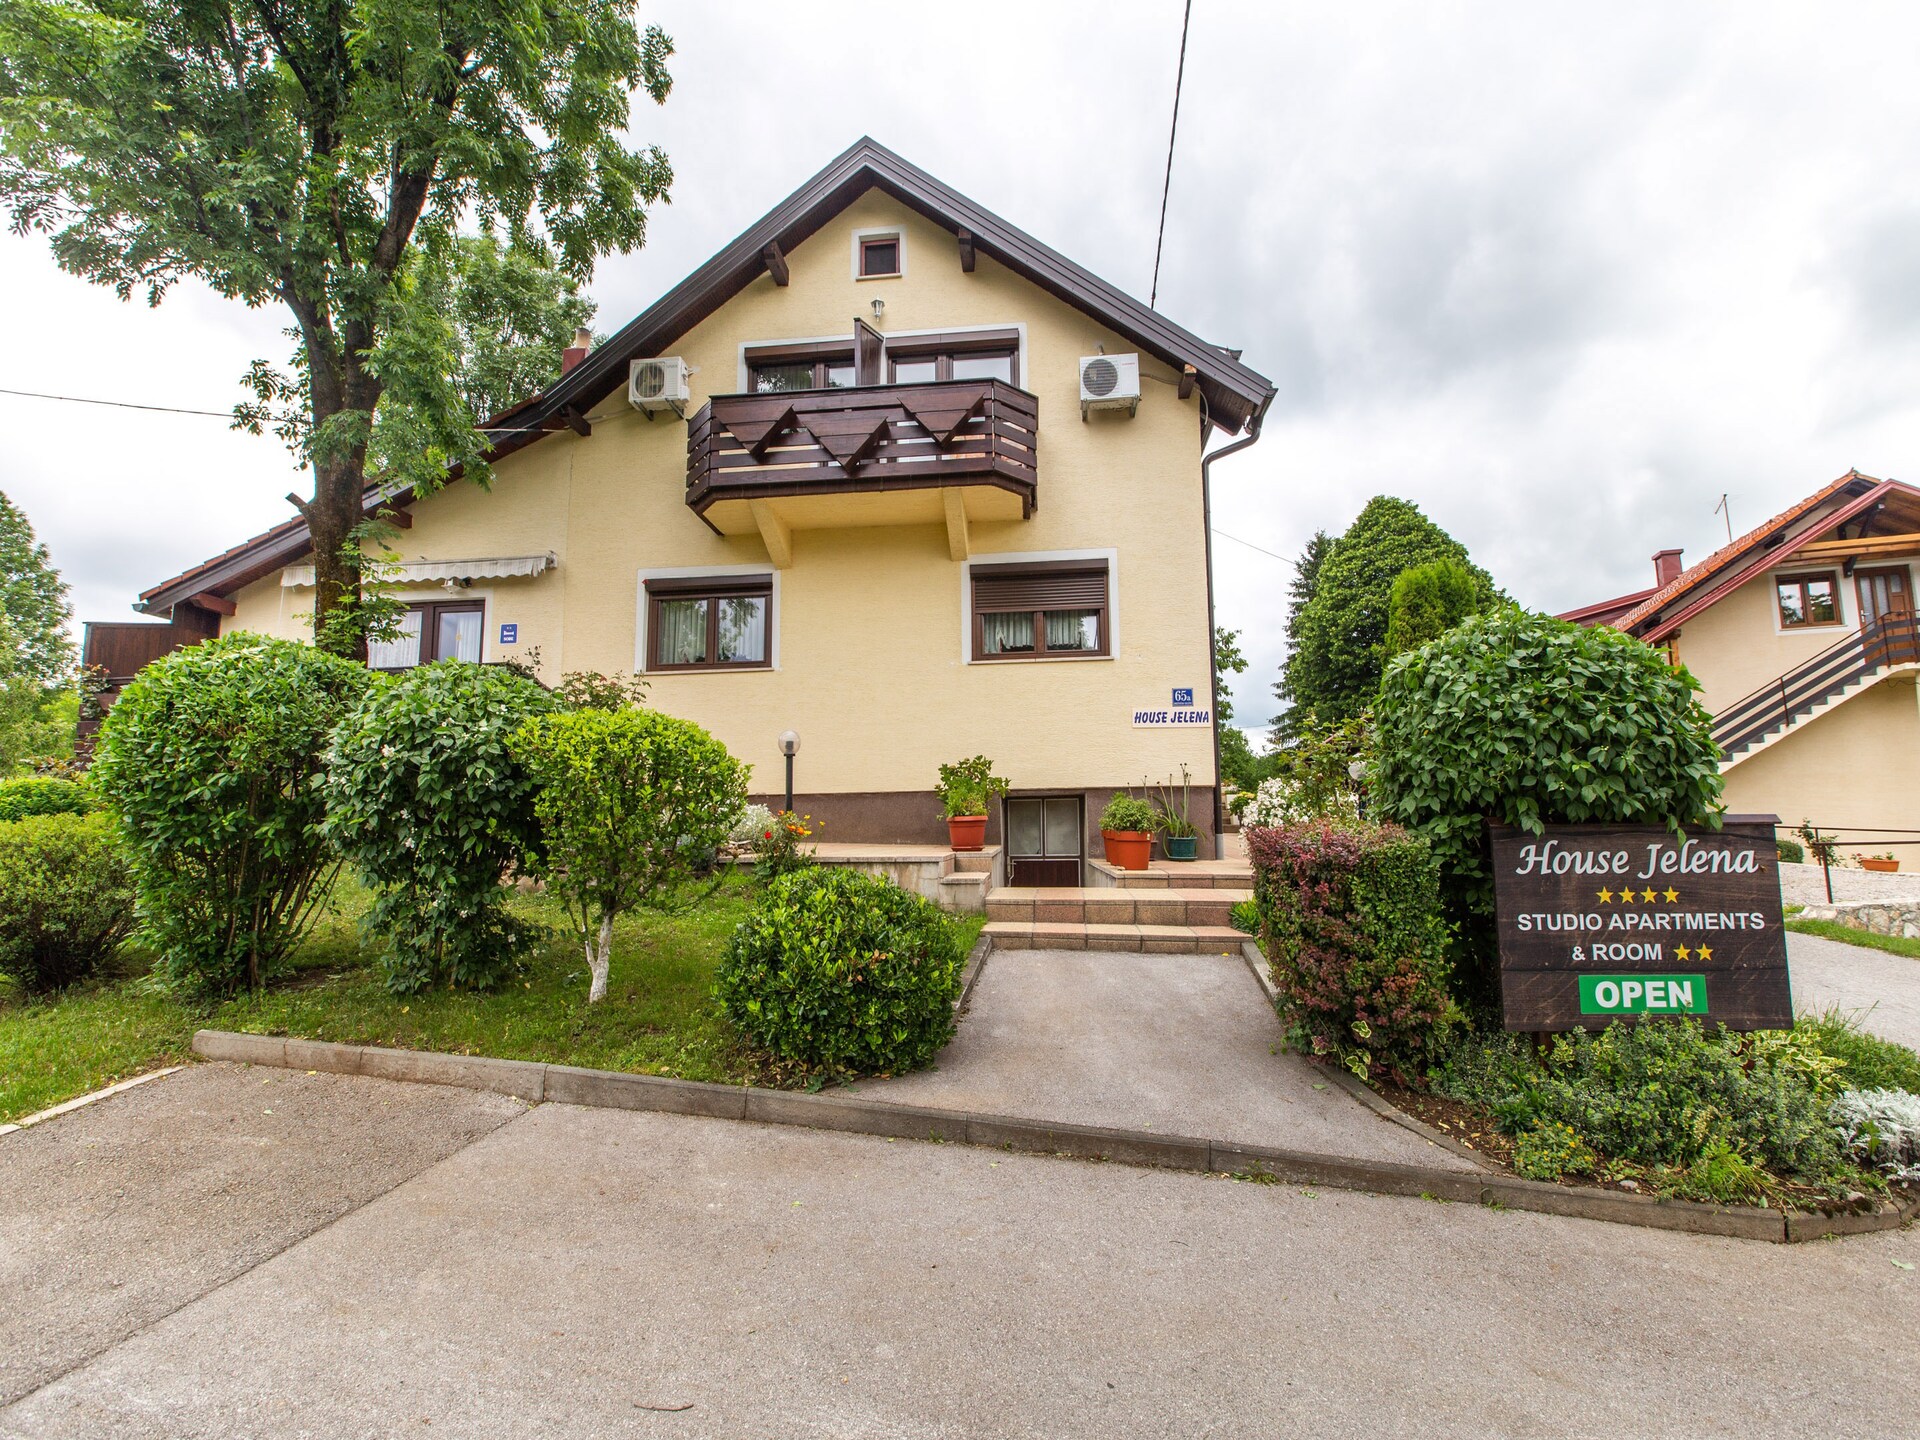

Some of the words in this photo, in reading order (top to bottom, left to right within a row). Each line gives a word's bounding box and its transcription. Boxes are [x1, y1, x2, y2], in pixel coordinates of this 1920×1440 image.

[1174, 690, 1191, 702] 65a
[1134, 711, 1168, 723] HOUSE
[1170, 711, 1209, 723] JELENA
[1515, 839, 1630, 875] House
[1637, 838, 1760, 880] Jelena
[1517, 913, 1603, 931] STUDIO
[1608, 912, 1766, 931] APARTMENTS
[1571, 945, 1586, 961] &
[1592, 942, 1663, 961] ROOM
[1594, 980, 1694, 1008] OPEN
